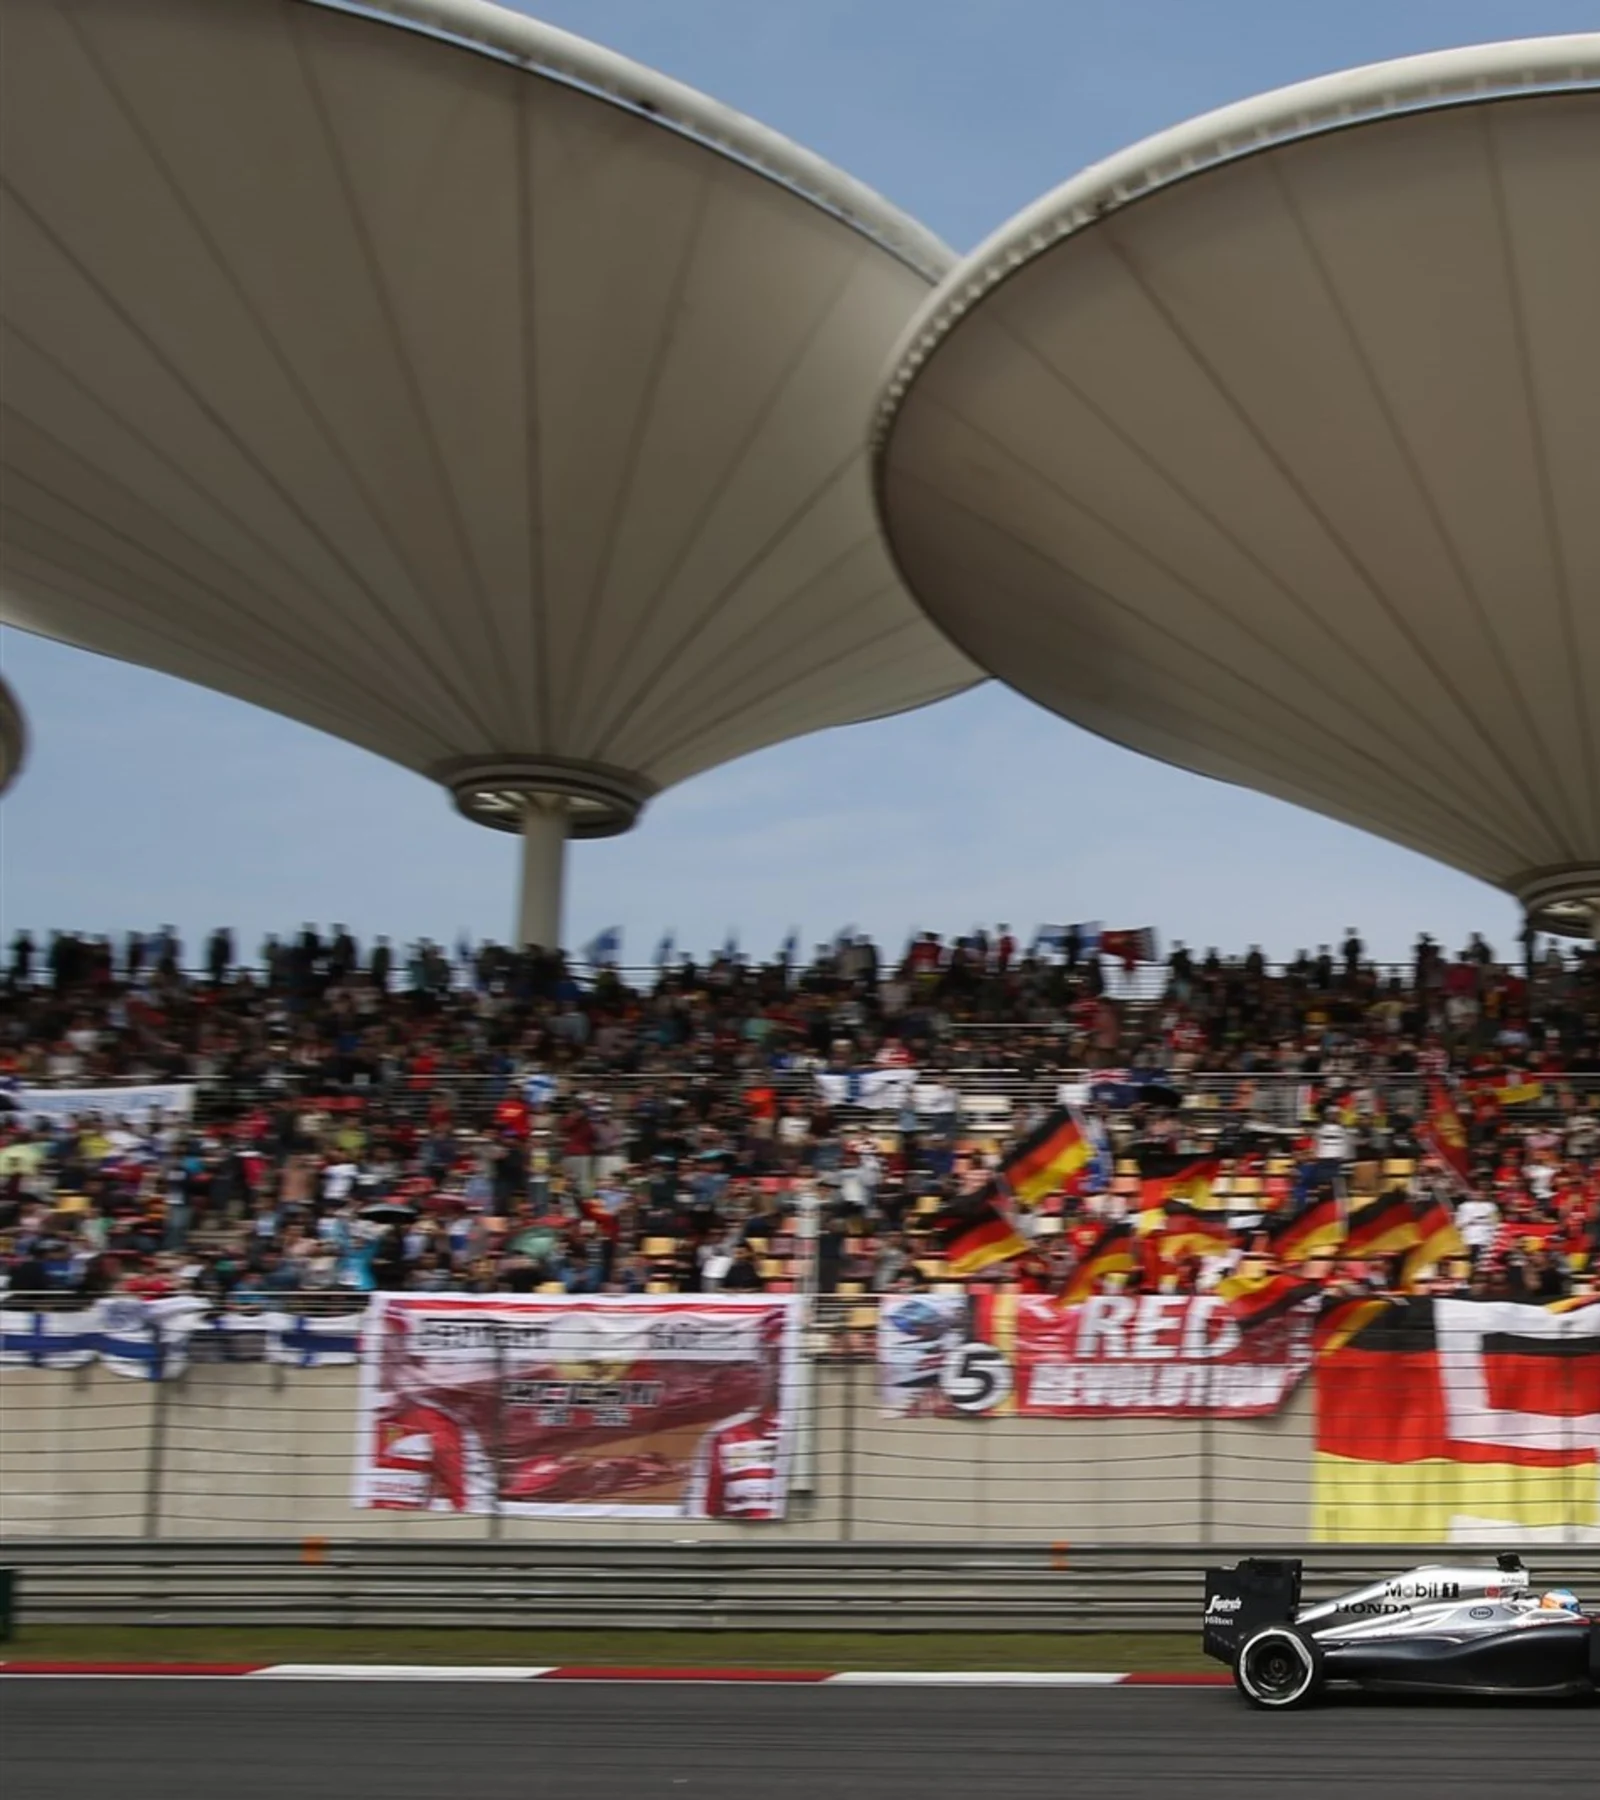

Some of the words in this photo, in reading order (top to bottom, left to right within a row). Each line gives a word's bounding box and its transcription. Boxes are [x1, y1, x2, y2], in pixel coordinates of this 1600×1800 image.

[1077, 1295, 1241, 1358] RED
[948, 1351, 1005, 1404] 5
[1385, 1582, 1437, 1599] Mobil
[1442, 1582, 1460, 1598] 1
[1334, 1603, 1412, 1615] HONDA
